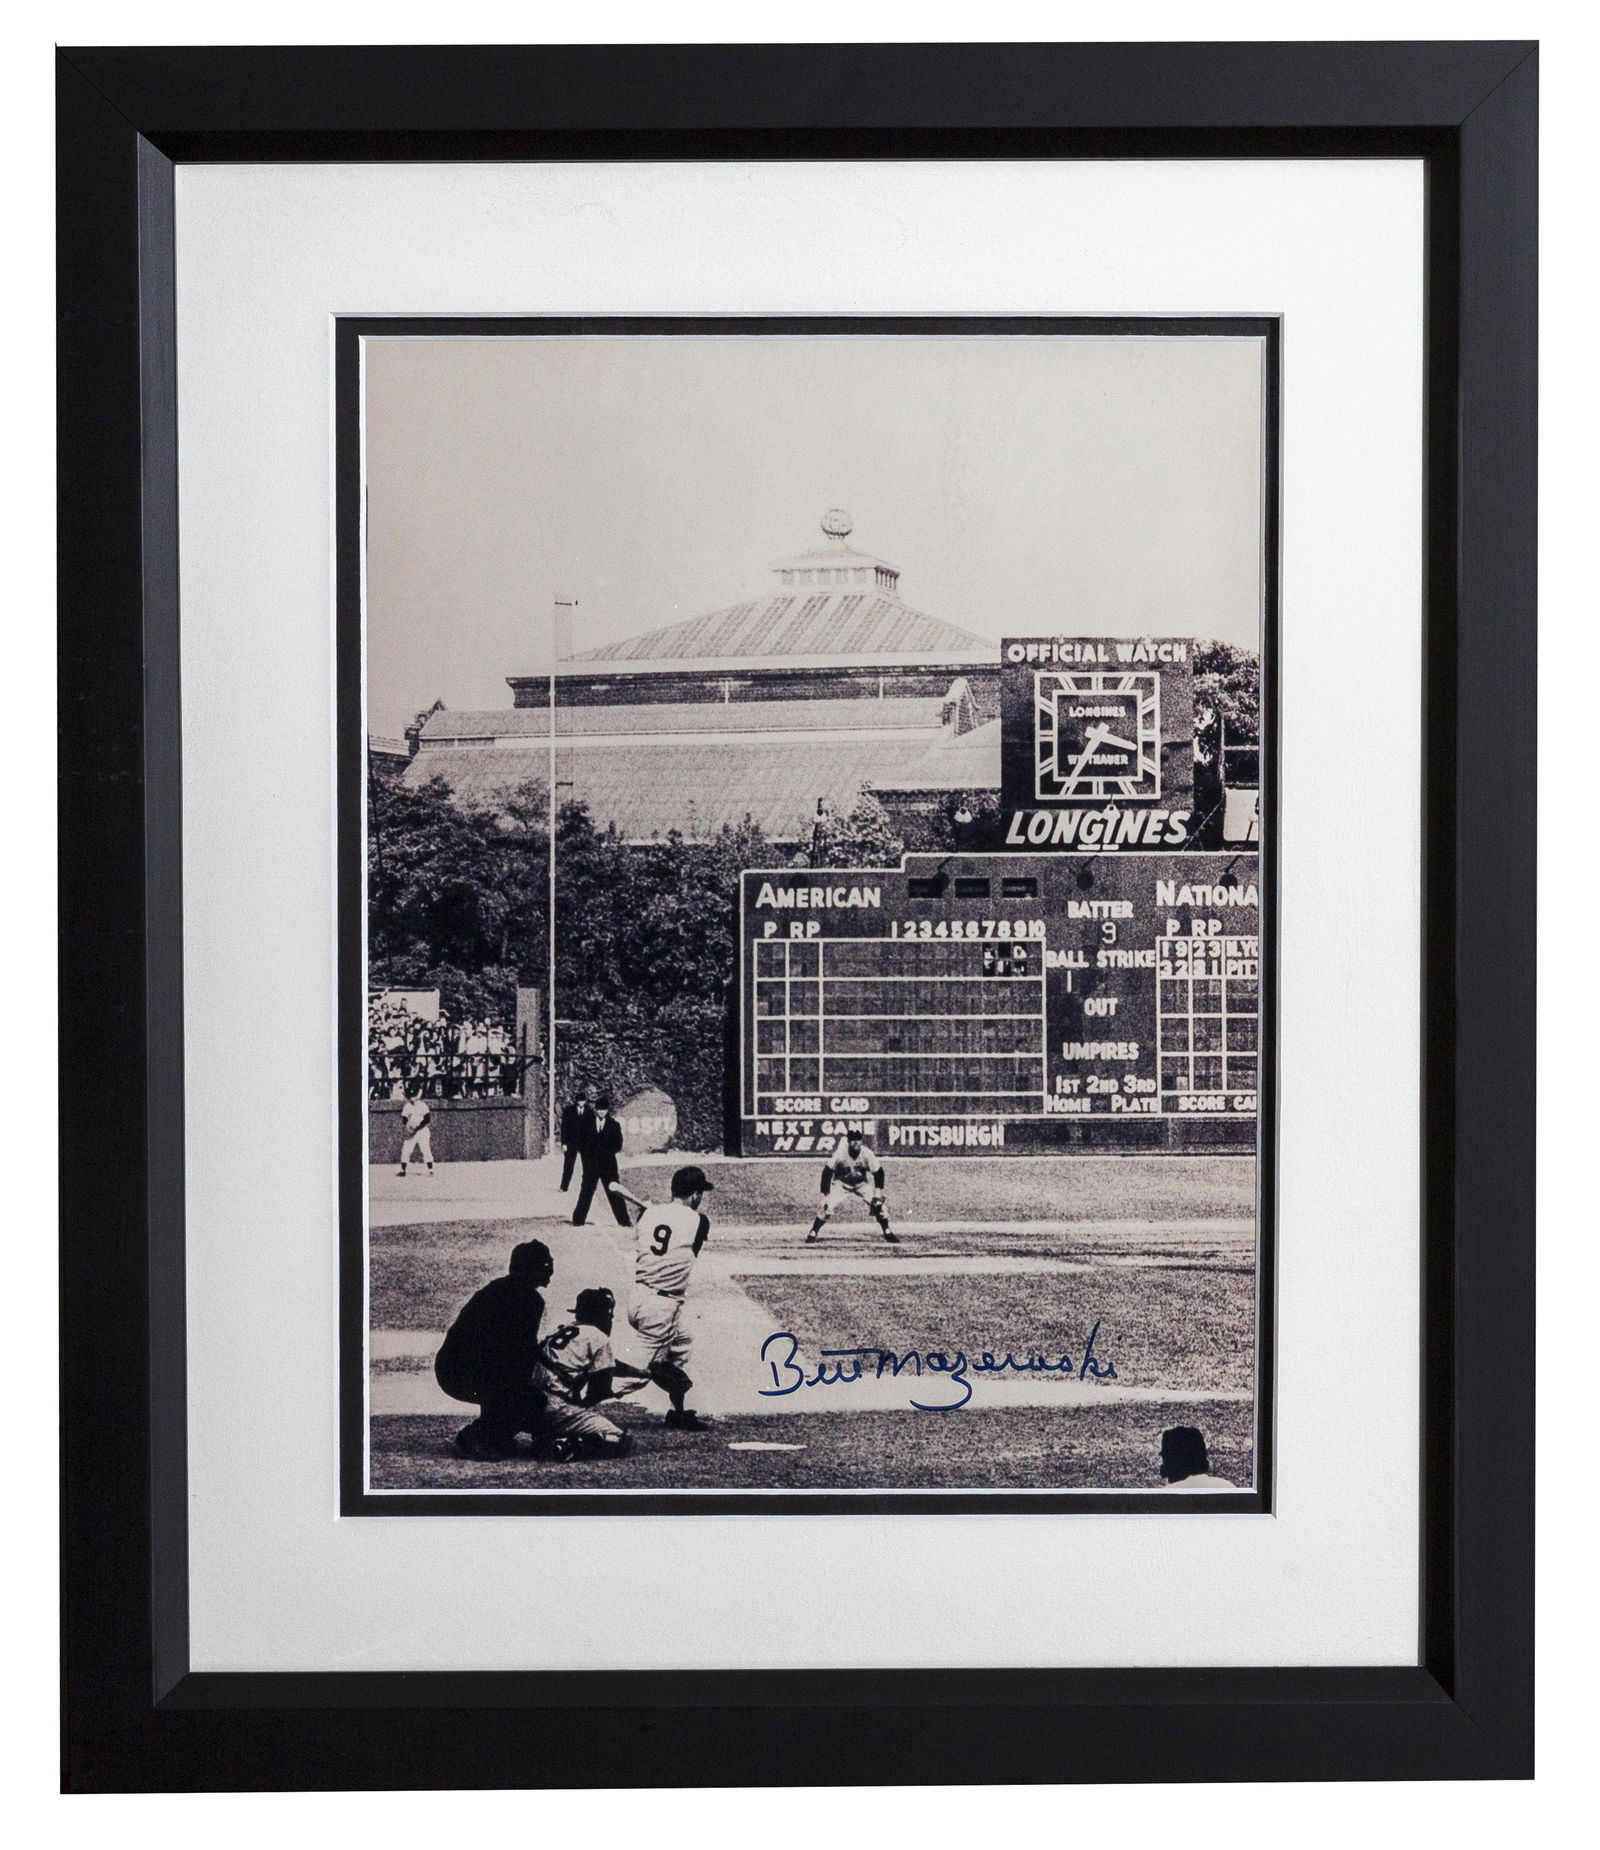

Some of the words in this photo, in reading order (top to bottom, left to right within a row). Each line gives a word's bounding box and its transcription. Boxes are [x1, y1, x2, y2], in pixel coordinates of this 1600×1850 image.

[1007, 644, 1110, 663] OFFICIAL
[1115, 643, 1187, 663] WATCH
[1069, 705, 1127, 718] LONGINES
[1067, 753, 1129, 766] WTNAUER
[1005, 809, 1191, 844] LONGINES
[755, 881, 881, 909] AMERICAN
[1067, 900, 1134, 919] BATTER
[1046, 950, 1089, 969] BALL
[1097, 950, 1157, 969] STRIKE
[1084, 998, 1119, 1016] OUT
[1062, 1042, 1140, 1060] UMPIRES
[775, 1098, 822, 1113] SCORE
[830, 1098, 870, 1113] CARD
[1047, 1095, 1092, 1113] HOME
[1111, 1095, 1159, 1113] PLATE
[1178, 1096, 1226, 1112] SCORE
[756, 1121, 814, 1136] NEXT
[821, 1121, 877, 1136] GAME
[888, 1125, 1005, 1147] PITTSBURGH
[650, 1224, 673, 1256] 9
